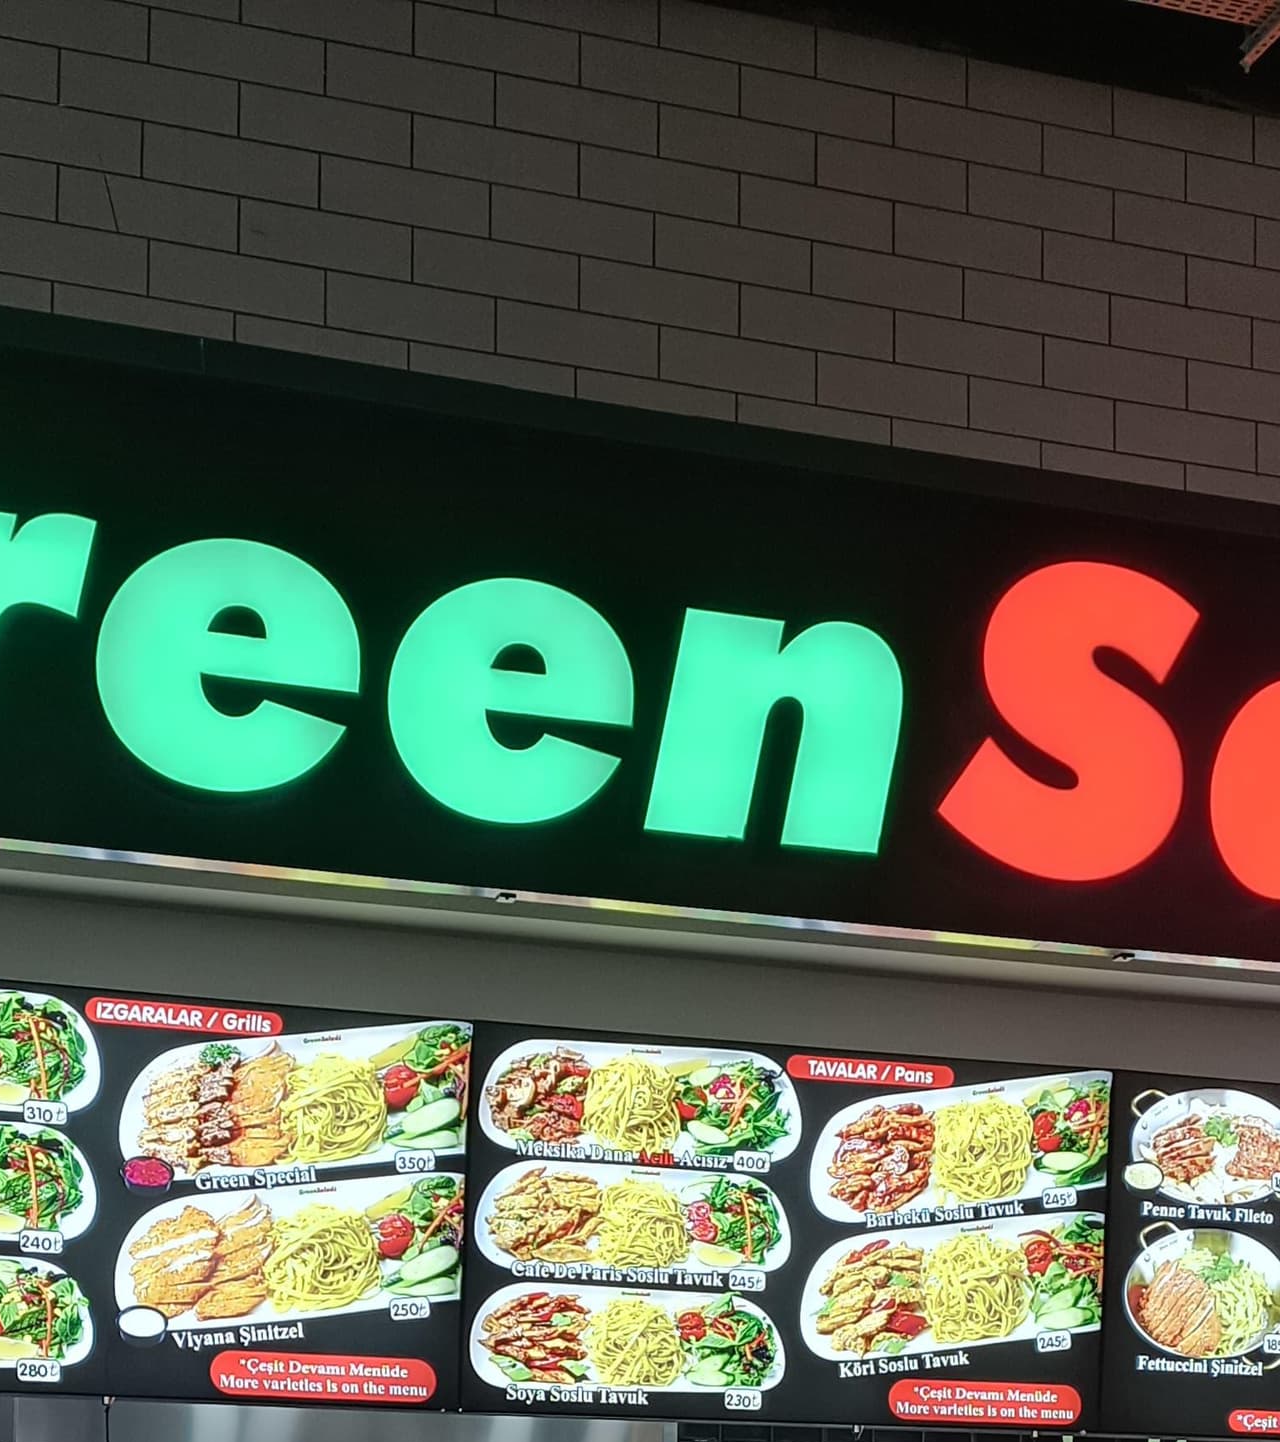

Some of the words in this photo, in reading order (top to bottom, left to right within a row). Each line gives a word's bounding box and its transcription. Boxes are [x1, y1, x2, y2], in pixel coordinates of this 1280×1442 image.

[222, 1013, 272, 1033] Grills
[807, 1059, 877, 1080] TAVALAR
[894, 1066, 934, 1084] Pans
[515, 1138, 587, 1159] Meksika
[590, 1143, 634, 1163] Dana
[195, 1169, 250, 1191] Green
[254, 1165, 317, 1189] Special
[865, 1206, 932, 1229] Barbekü
[933, 1205, 974, 1224] Soslu
[976, 1202, 1025, 1220] Tavuk
[1141, 1201, 1185, 1219] Penne
[1187, 1204, 1231, 1222] Tavuk
[1234, 1207, 1275, 1225] Fileto
[511, 1260, 551, 1279] Cafe
[553, 1263, 578, 1280] De
[581, 1264, 623, 1283] Paris
[625, 1266, 670, 1285] Soslu
[672, 1269, 725, 1288] Tavuk
[171, 1329, 235, 1352] Viyana
[238, 1321, 305, 1347] Şinitzel
[288, 1360, 346, 1377] Devamı
[348, 1362, 409, 1378] Menüde
[838, 1359, 876, 1379] Köri
[878, 1356, 919, 1375] Soslu
[921, 1352, 971, 1371] Tavuk
[1136, 1355, 1208, 1374] Fettuccini
[1210, 1358, 1263, 1378] Şinitzel
[220, 1374, 260, 1390] More
[262, 1377, 323, 1392] varieties
[326, 1378, 338, 1393] is
[341, 1381, 360, 1394] on
[362, 1380, 386, 1395] the
[388, 1383, 428, 1397] menu
[506, 1384, 546, 1405] Soya
[549, 1386, 593, 1404] Soslu
[598, 1388, 650, 1406] Tavuk
[954, 1387, 1005, 1402] Devamı
[1007, 1388, 1058, 1404] Menüde
[895, 1400, 930, 1416] More
[932, 1402, 985, 1418] varieties
[999, 1406, 1016, 1418] on
[1018, 1405, 1038, 1419] the
[1040, 1408, 1074, 1421] menu
